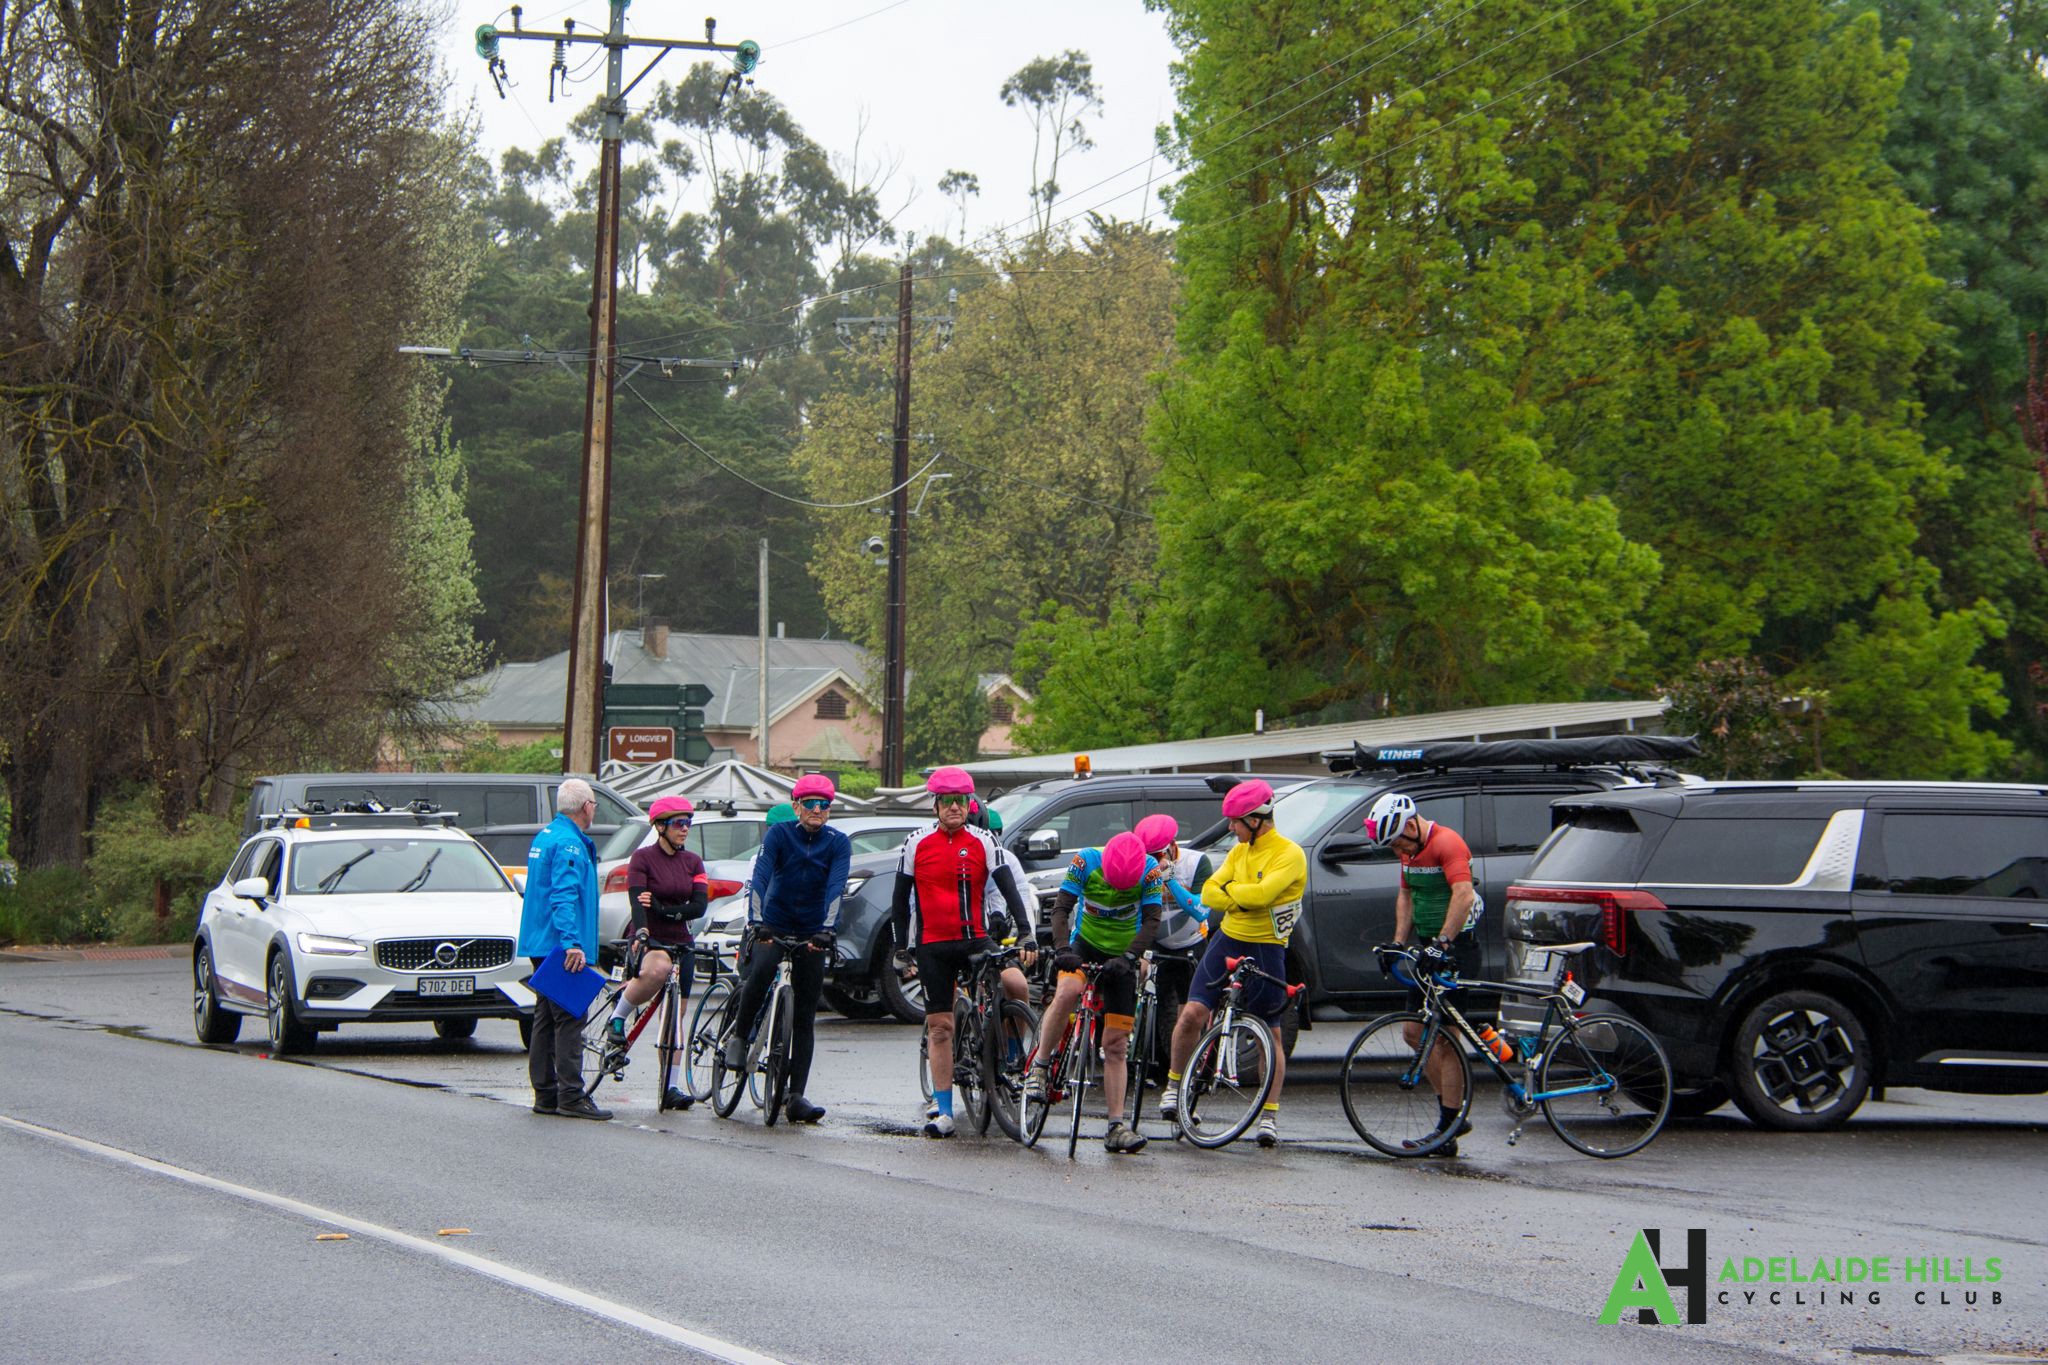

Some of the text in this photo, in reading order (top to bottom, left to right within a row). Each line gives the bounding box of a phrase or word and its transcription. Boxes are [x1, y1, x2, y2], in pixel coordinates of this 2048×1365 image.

[629, 735, 668, 743] LONGVIEW
[1377, 750, 1423, 760] KINGS
[1275, 908, 1294, 933] 183
[420, 980, 473, 993] S702 DEE
